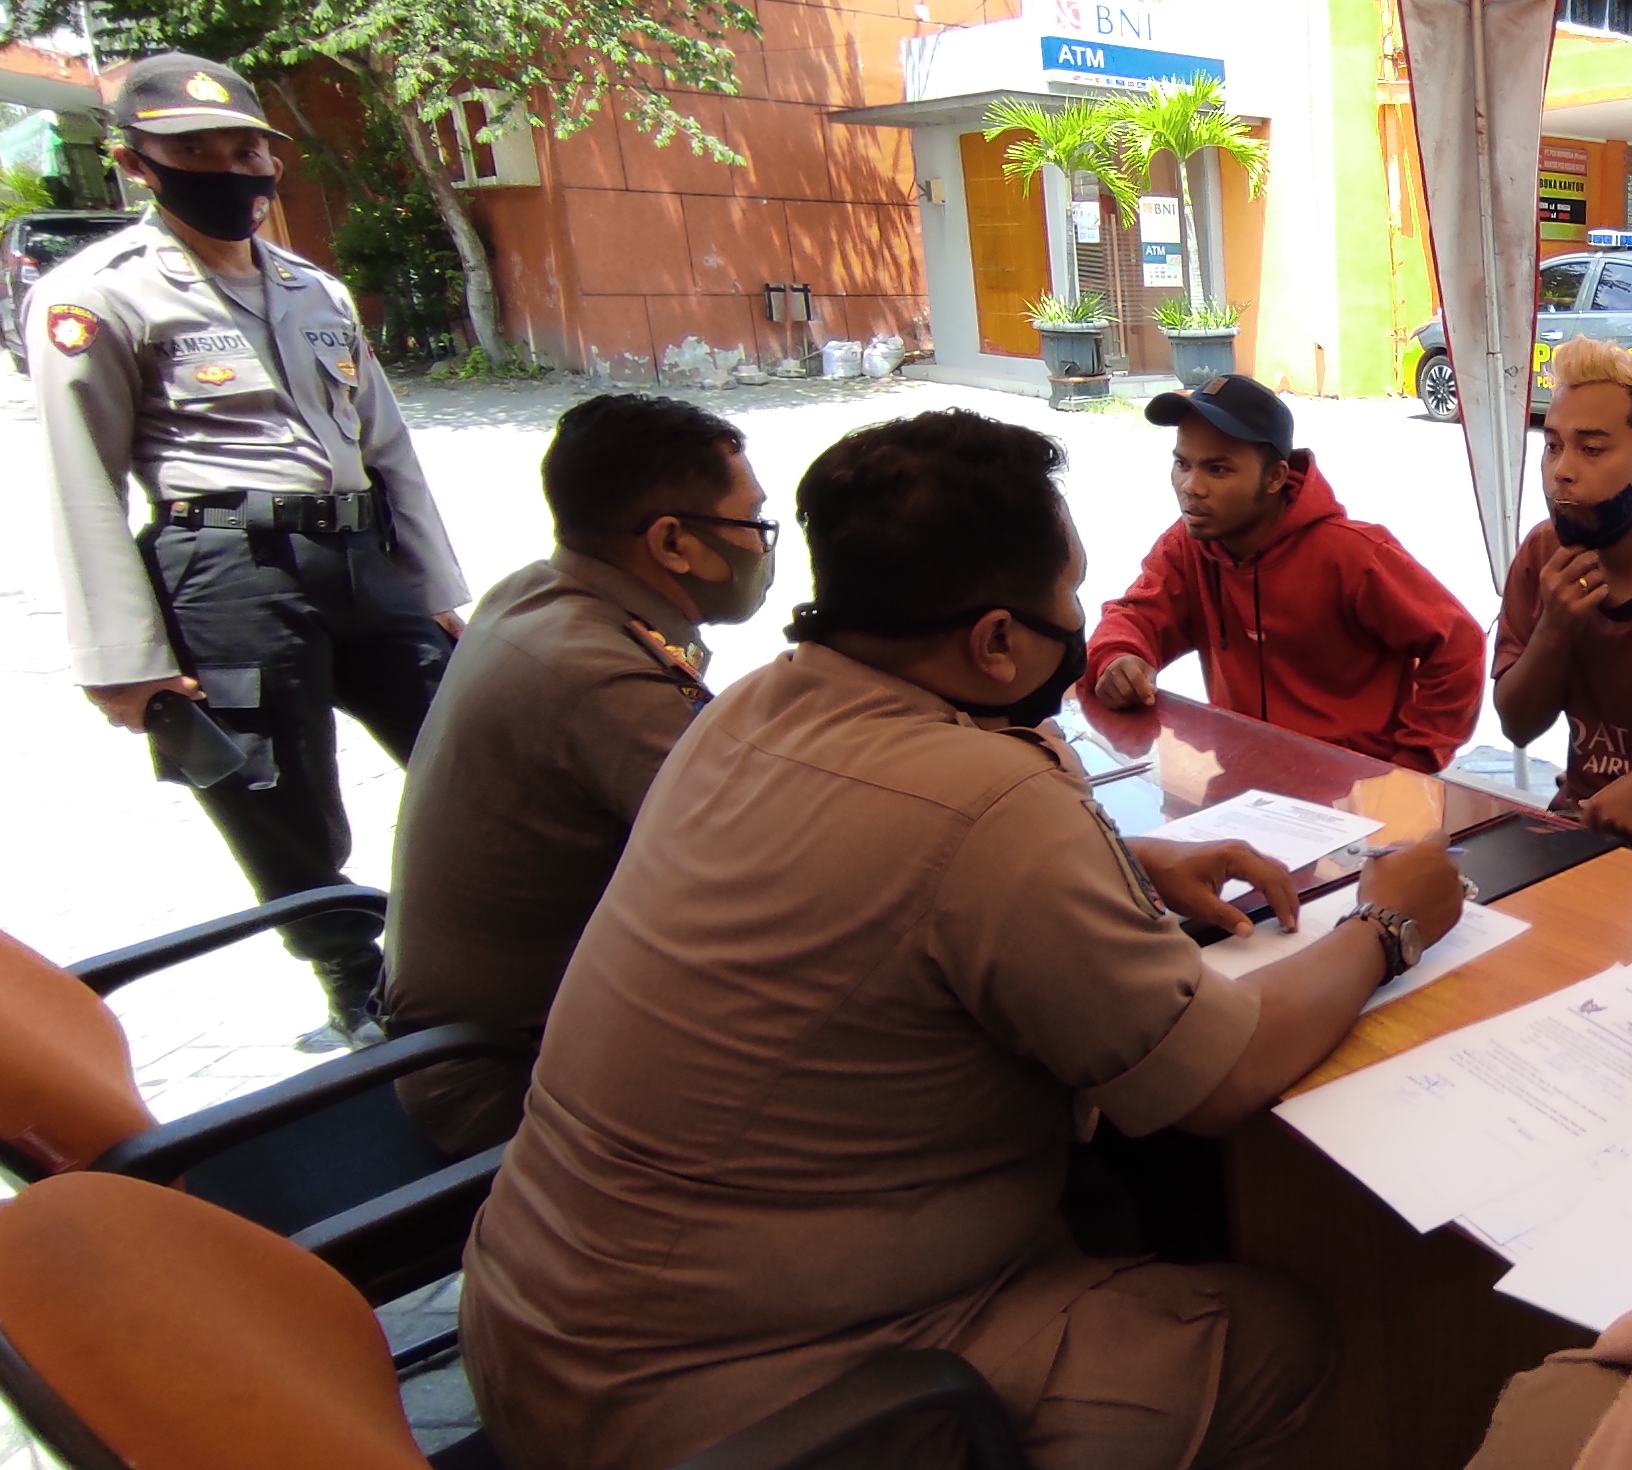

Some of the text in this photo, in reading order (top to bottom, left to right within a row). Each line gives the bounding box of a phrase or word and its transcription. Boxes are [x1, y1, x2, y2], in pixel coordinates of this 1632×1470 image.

[1096, 5, 1152, 40] BNI
[1058, 44, 1105, 69] ATM
[1154, 203, 1176, 215] BNI
[1145, 245, 1166, 256] ATM
